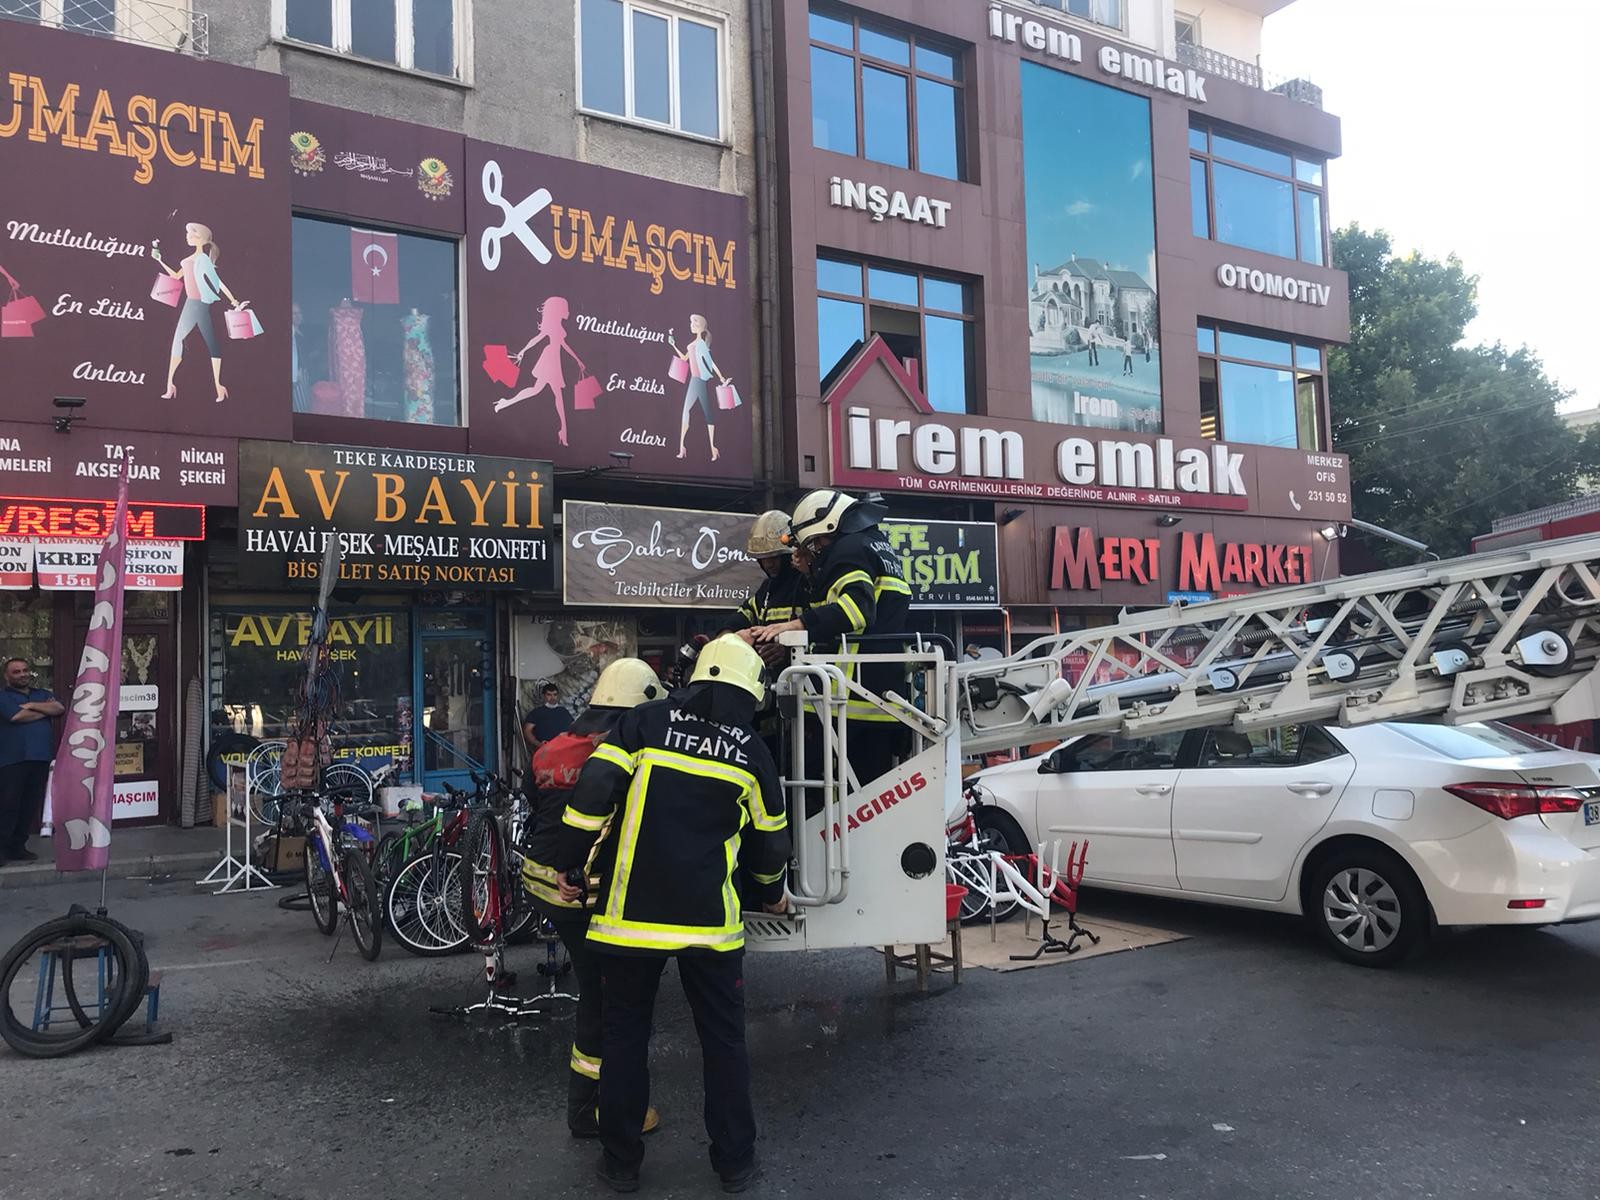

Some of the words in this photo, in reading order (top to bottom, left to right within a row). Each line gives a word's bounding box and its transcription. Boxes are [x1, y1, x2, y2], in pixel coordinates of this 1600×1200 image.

[989, 3, 1082, 63] irem
[1098, 46, 1208, 103] emlak
[7, 220, 145, 257] Mutluluğun
[52, 294, 82, 317] En
[89, 298, 145, 321] Lüks
[576, 315, 665, 344] Mutluluğun
[73, 361, 145, 385] Anları
[606, 373, 626, 392] En
[629, 376, 665, 395] Lüks
[0, 438, 21, 451] NA
[620, 428, 666, 447] Anları
[848, 406, 1025, 480] irem
[1057, 437, 1248, 496] emlak
[181, 447, 224, 465] NİKAH
[333, 450, 377, 467] TEKE
[381, 452, 476, 475] KARDEŞLER
[1307, 455, 1343, 468] MERKEZ
[180, 469, 226, 486] ŞEKERİ
[899, 476, 923, 489] TÜM
[1047, 486, 1103, 500] DEĞERİNDE
[1107, 489, 1137, 501] ALINIR
[1148, 494, 1181, 505] SATILIR
[252, 467, 350, 521] AV
[1308, 490, 1323, 501] 231
[1325, 492, 1335, 502] 50
[1337, 493, 1347, 503] 52
[246, 526, 316, 553] HAVAİ
[384, 534, 459, 562] MEŞALE
[288, 558, 374, 581] BİSLET
[378, 563, 430, 585] SATIŞ
[435, 566, 515, 583] NOKTASI
[896, 546, 982, 592] İŞİM
[1051, 526, 1160, 590] MERT
[1178, 531, 1313, 591] MARKET
[614, 581, 693, 598] Tesbihciler
[696, 583, 750, 599] Kahvesi
[231, 616, 290, 646] AV
[664, 727, 748, 765] İTFAİYE
